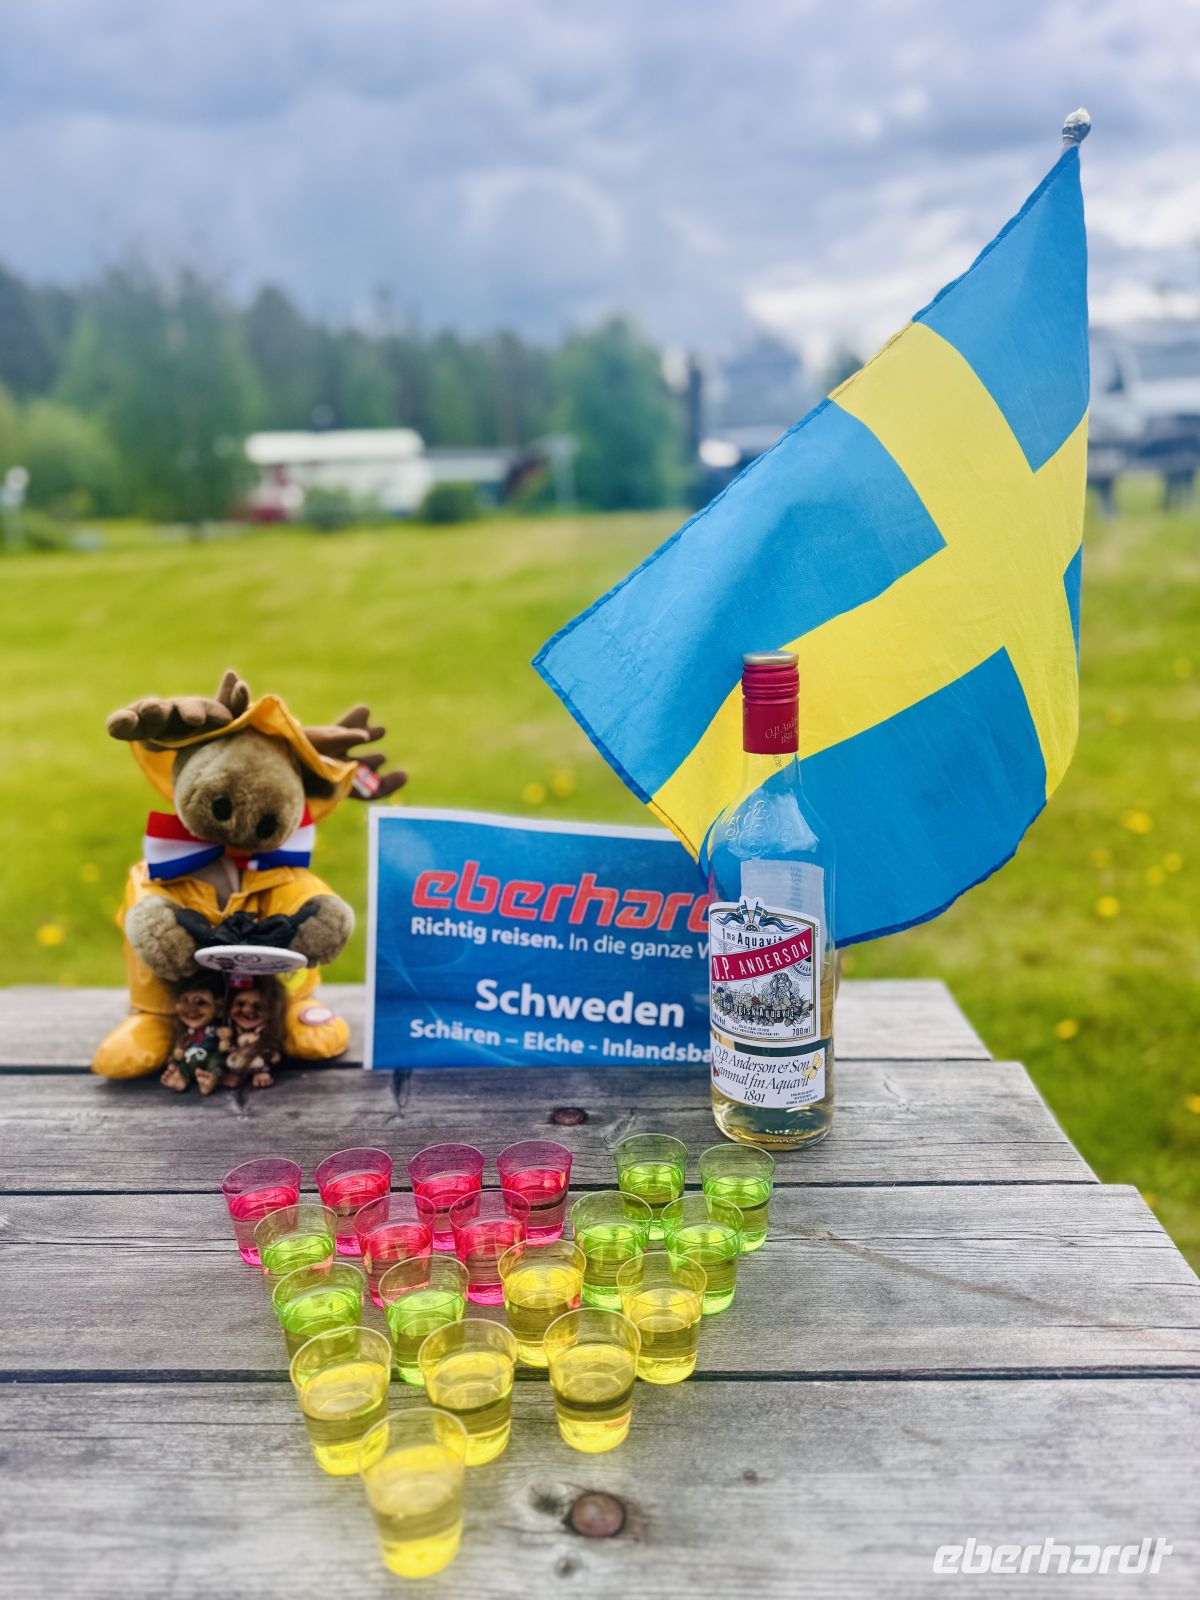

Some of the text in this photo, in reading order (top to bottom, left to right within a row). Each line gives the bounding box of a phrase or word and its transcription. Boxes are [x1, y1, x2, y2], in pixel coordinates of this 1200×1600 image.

[411, 916, 487, 943] Richtig
[491, 926, 564, 950] reisen.
[569, 933, 588, 951] In
[594, 935, 625, 955] die
[630, 942, 693, 960] ganze
[712, 957, 734, 980] O.P.
[739, 939, 809, 976] ANDERSON
[475, 978, 684, 1028] Schweden
[410, 1019, 500, 1047] Schären
[524, 1031, 584, 1054] Elche
[729, 1054, 777, 1074] Anderson
[778, 1062, 791, 1074] &
[790, 1059, 810, 1073] Son
[743, 1090, 766, 1104] 1891
[749, 1073, 765, 1090] fin
[765, 1077, 809, 1094] Aquavit
